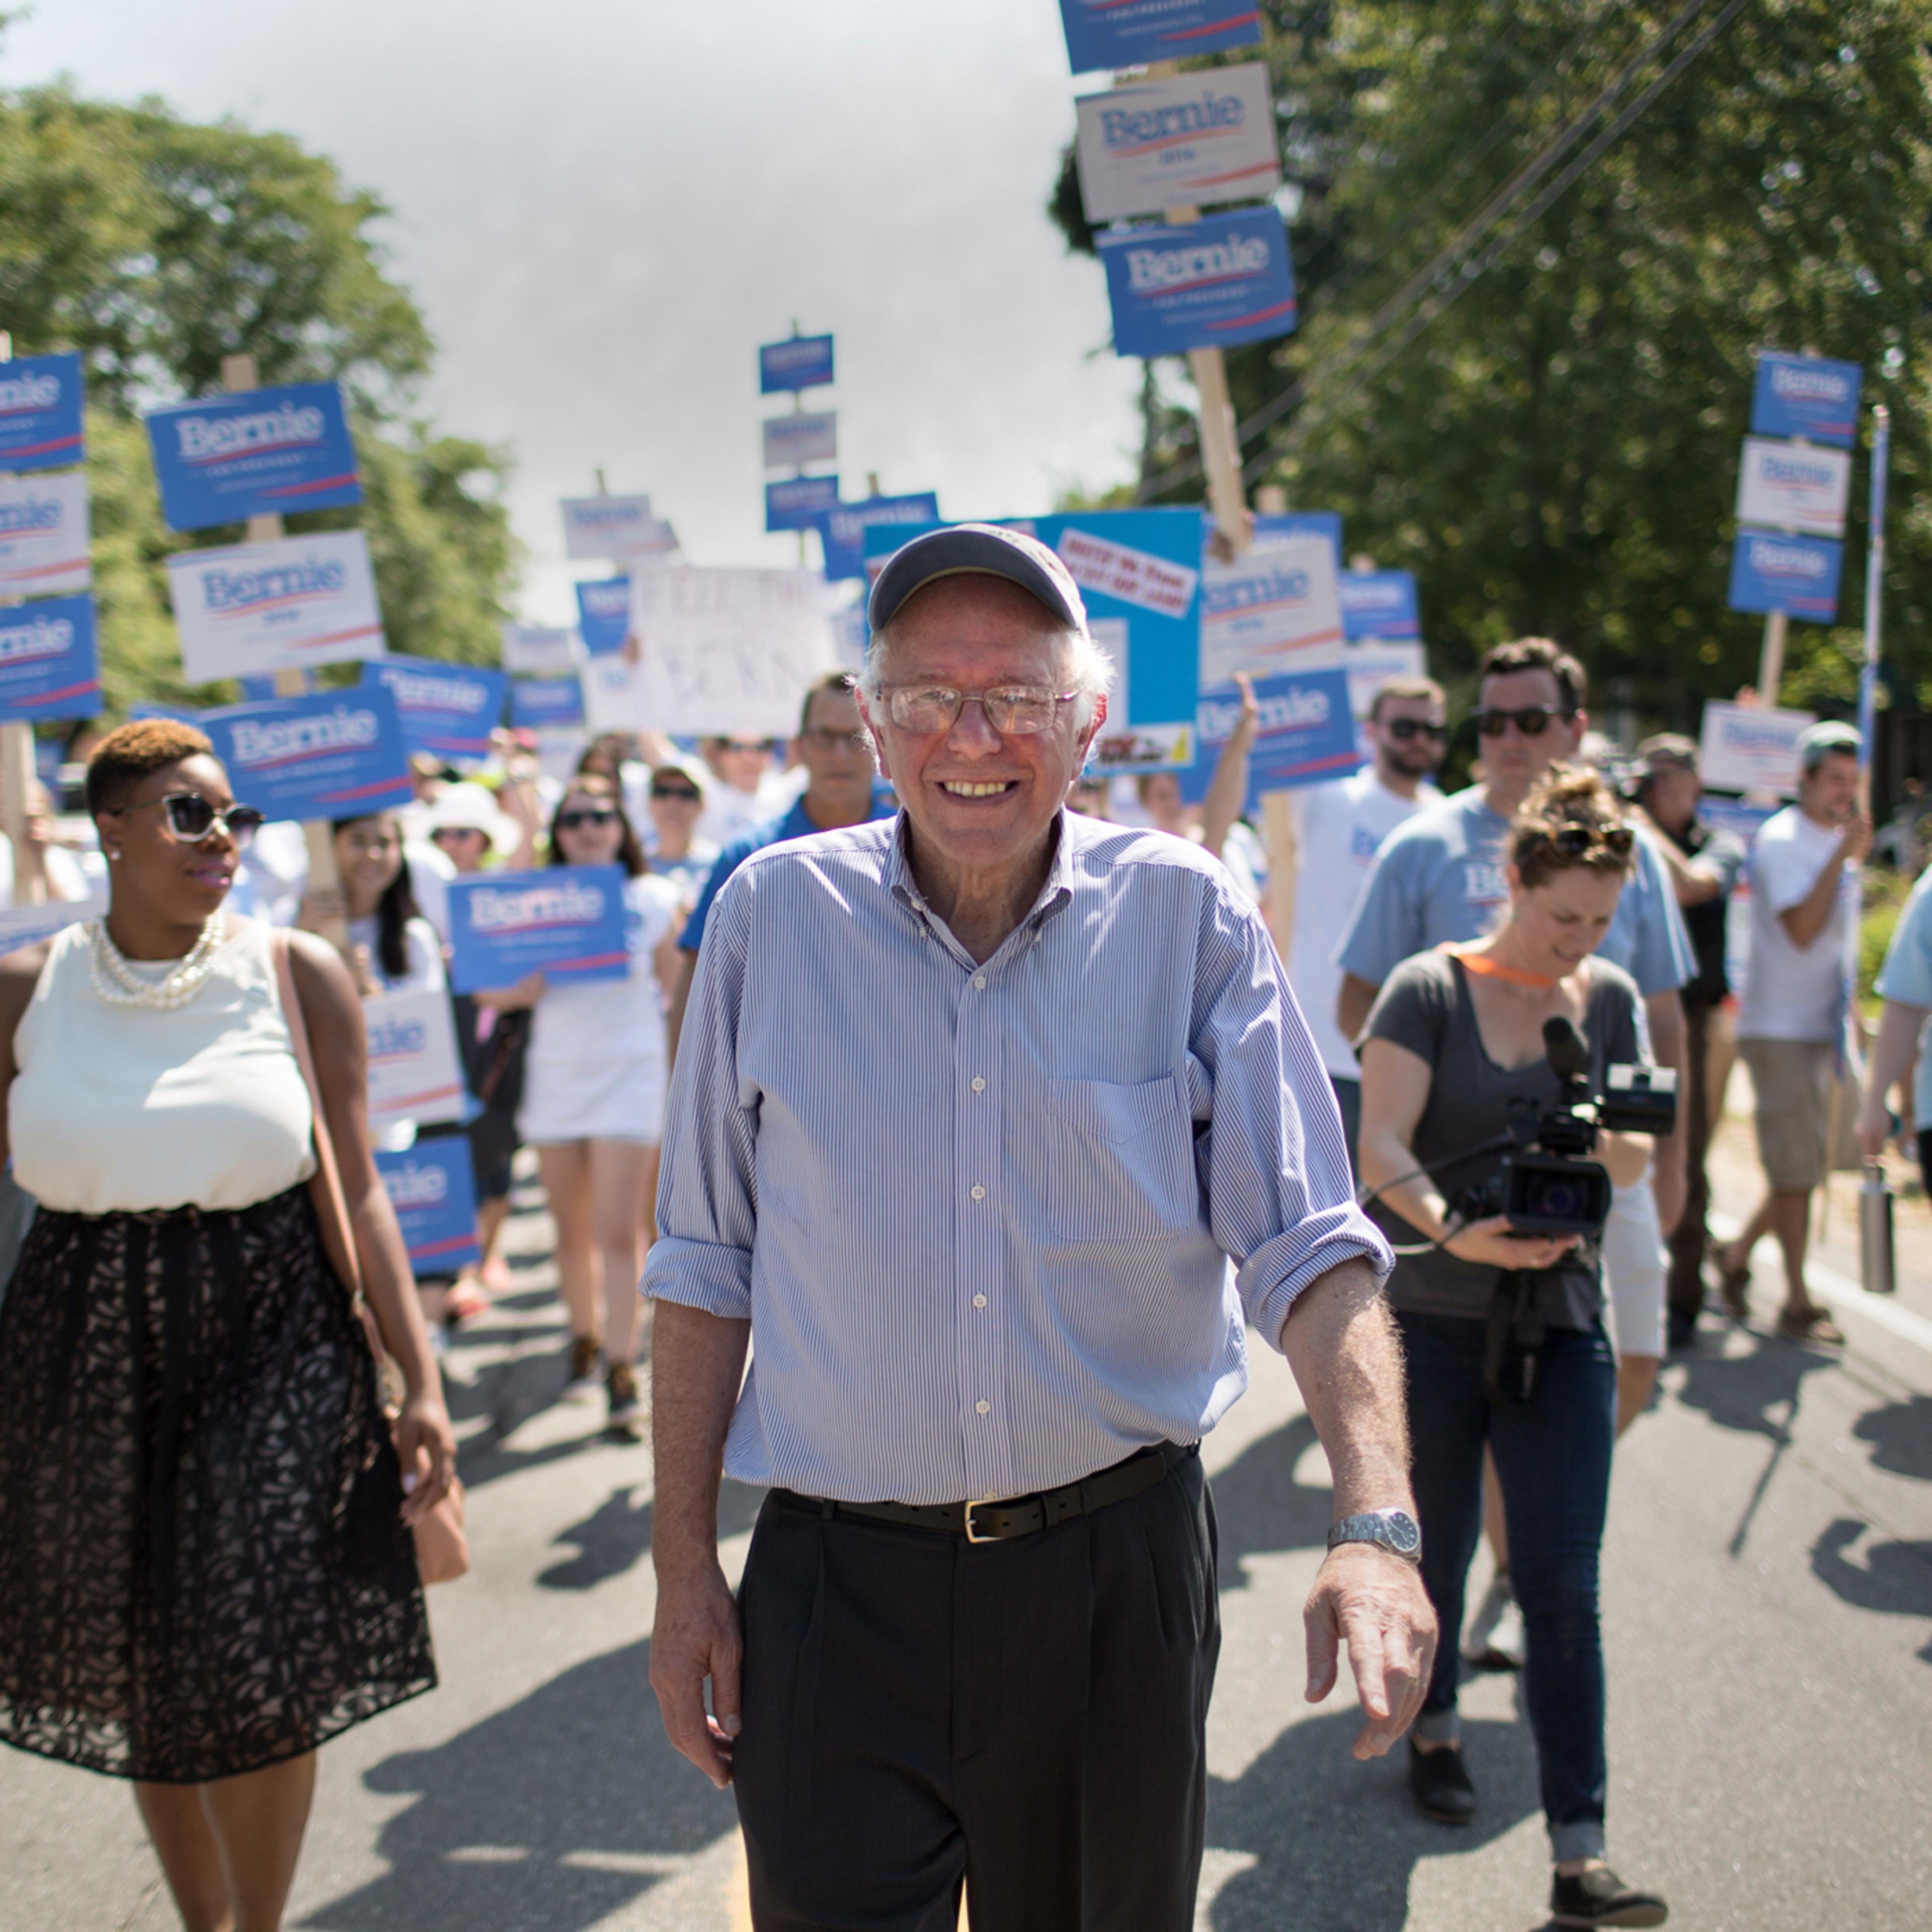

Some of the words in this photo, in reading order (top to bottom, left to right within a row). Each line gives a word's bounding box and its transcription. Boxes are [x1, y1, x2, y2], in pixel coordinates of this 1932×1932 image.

[1100, 92, 1244, 144] Bernie
[1125, 233, 1269, 288] Bernie
[0, 370, 61, 408] nie
[175, 401, 323, 455] Bernie
[202, 553, 347, 607] Bernie
[1203, 568, 1310, 611] ernie
[0, 615, 74, 659] rnie
[230, 704, 377, 761] Bernie
[470, 881, 603, 927] Bernie
[369, 1015, 426, 1053] nie
[383, 1160, 447, 1202] nie
